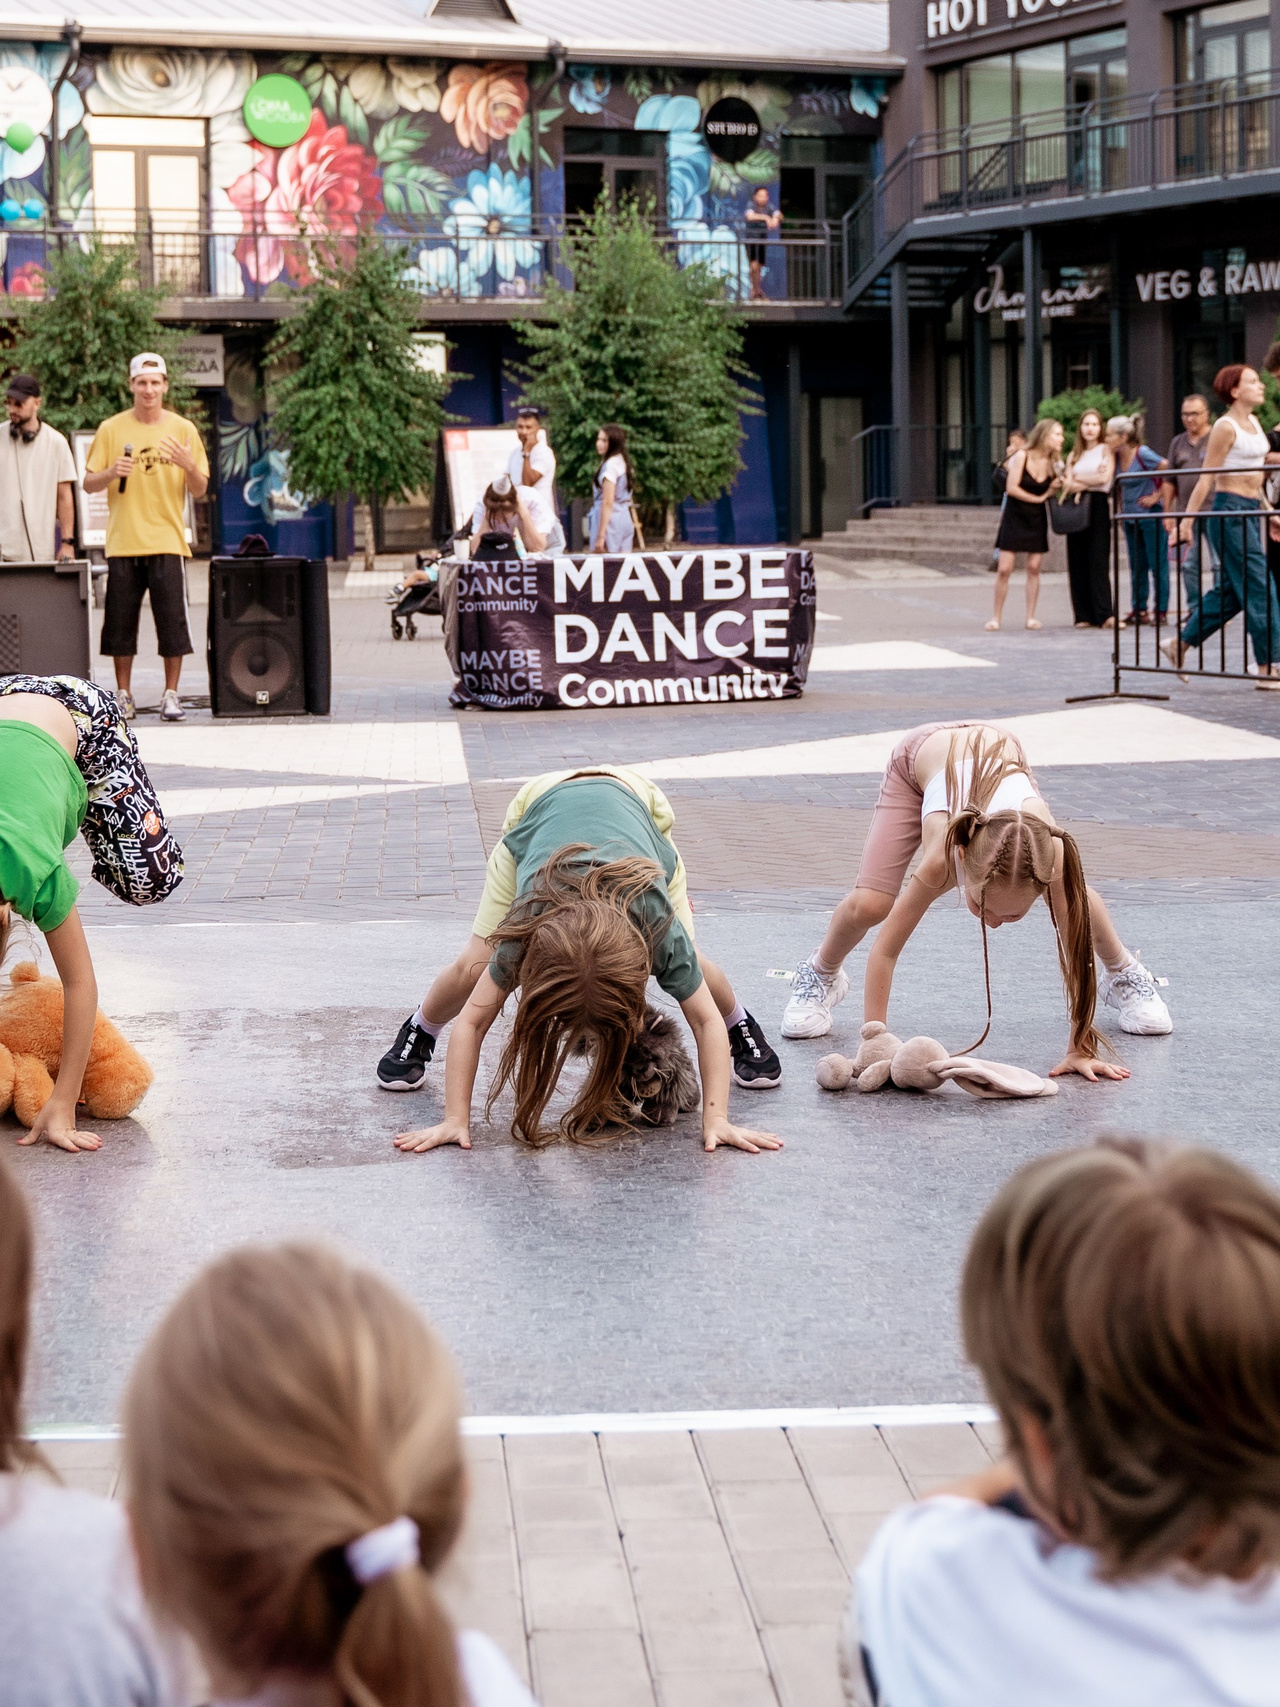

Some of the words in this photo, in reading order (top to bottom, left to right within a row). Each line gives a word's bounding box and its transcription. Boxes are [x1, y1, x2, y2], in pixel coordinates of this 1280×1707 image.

[1135, 268, 1192, 303] VEG
[1197, 265, 1218, 298] &
[1224, 260, 1280, 296] RAW
[456, 576, 538, 596] DANCE
[553, 551, 789, 603] MAYBE
[457, 598, 539, 613] Community
[554, 608, 789, 664] DANCE
[460, 649, 542, 671] MAYBE
[463, 671, 544, 691] DANCE
[558, 667, 788, 708] Community
[112, 787, 133, 802] LOCO
